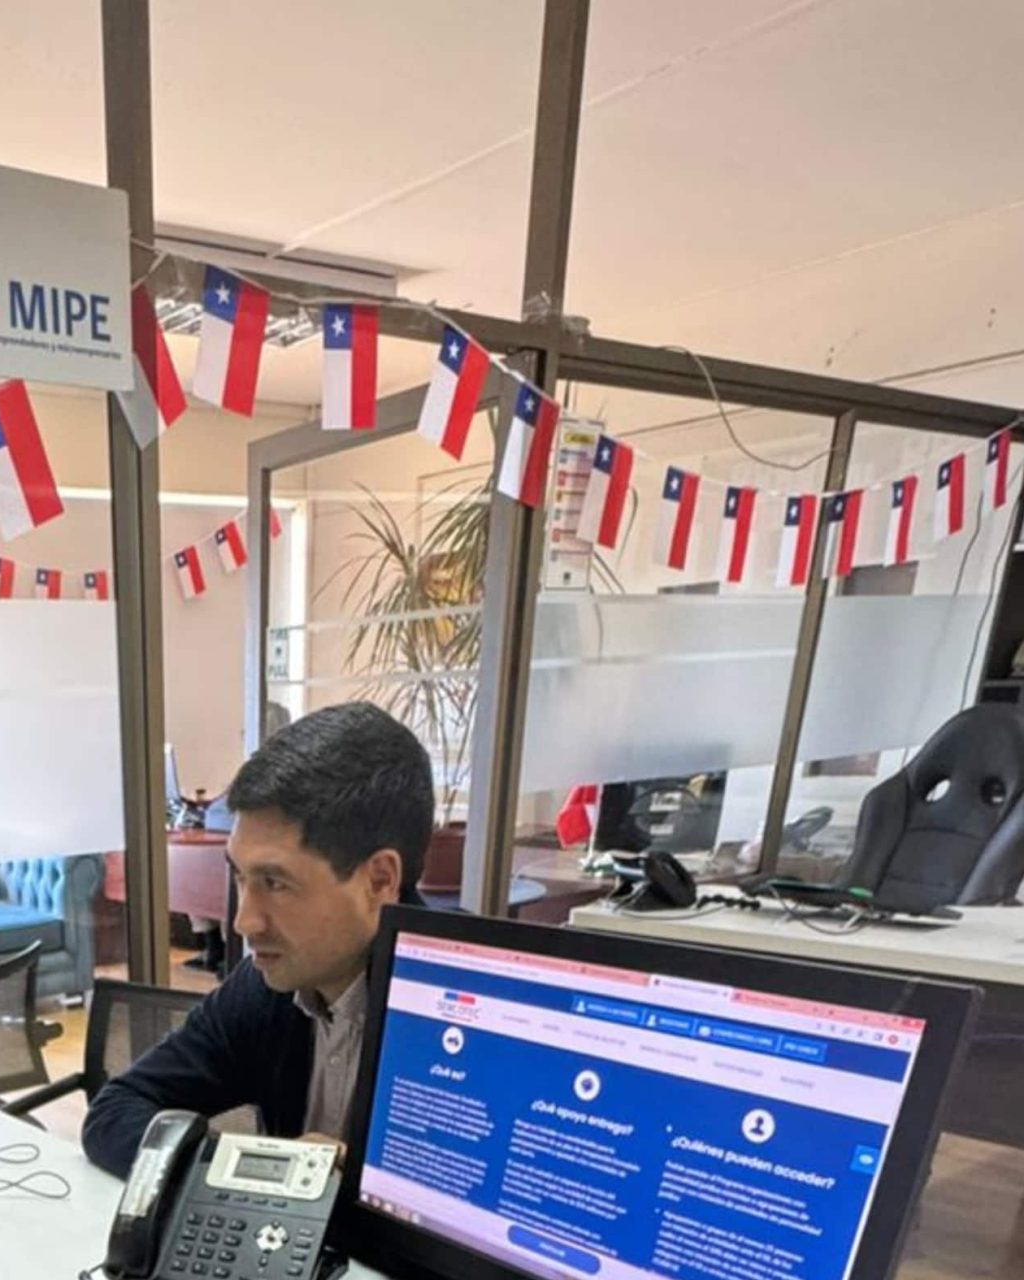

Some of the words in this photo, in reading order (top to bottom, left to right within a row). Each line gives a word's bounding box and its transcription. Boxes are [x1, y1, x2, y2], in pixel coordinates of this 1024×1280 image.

[8, 280, 112, 343] MIPE
[671, 1135, 725, 1160] ¿Quiénes
[724, 1150, 774, 1174] pueden
[773, 1163, 836, 1190] acceder?
